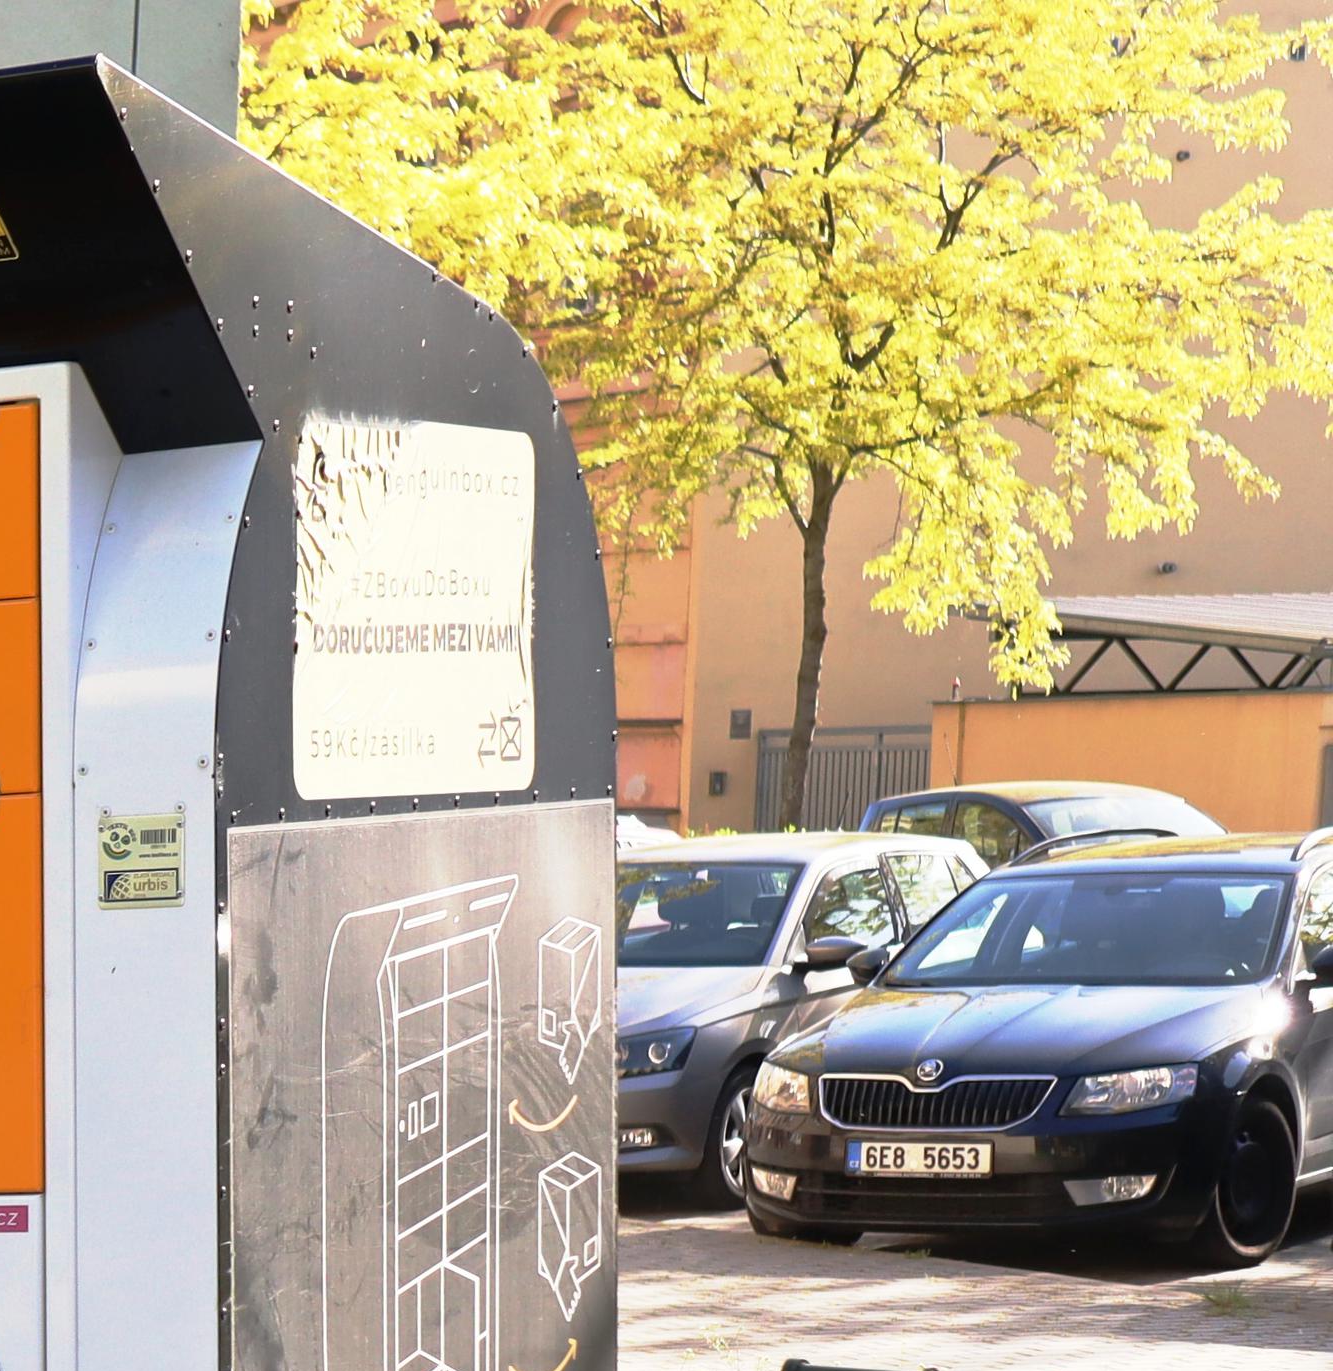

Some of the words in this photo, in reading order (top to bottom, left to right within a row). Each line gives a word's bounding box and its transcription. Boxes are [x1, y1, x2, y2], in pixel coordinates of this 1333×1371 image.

[313, 618, 430, 654] DORUČUJEME
[433, 623, 472, 652] MEZI
[475, 616, 518, 653] VÁMI!
[133, 879, 168, 891] urbis
[865, 1146, 906, 1169] 6E8
[923, 1146, 981, 1170] 5653
